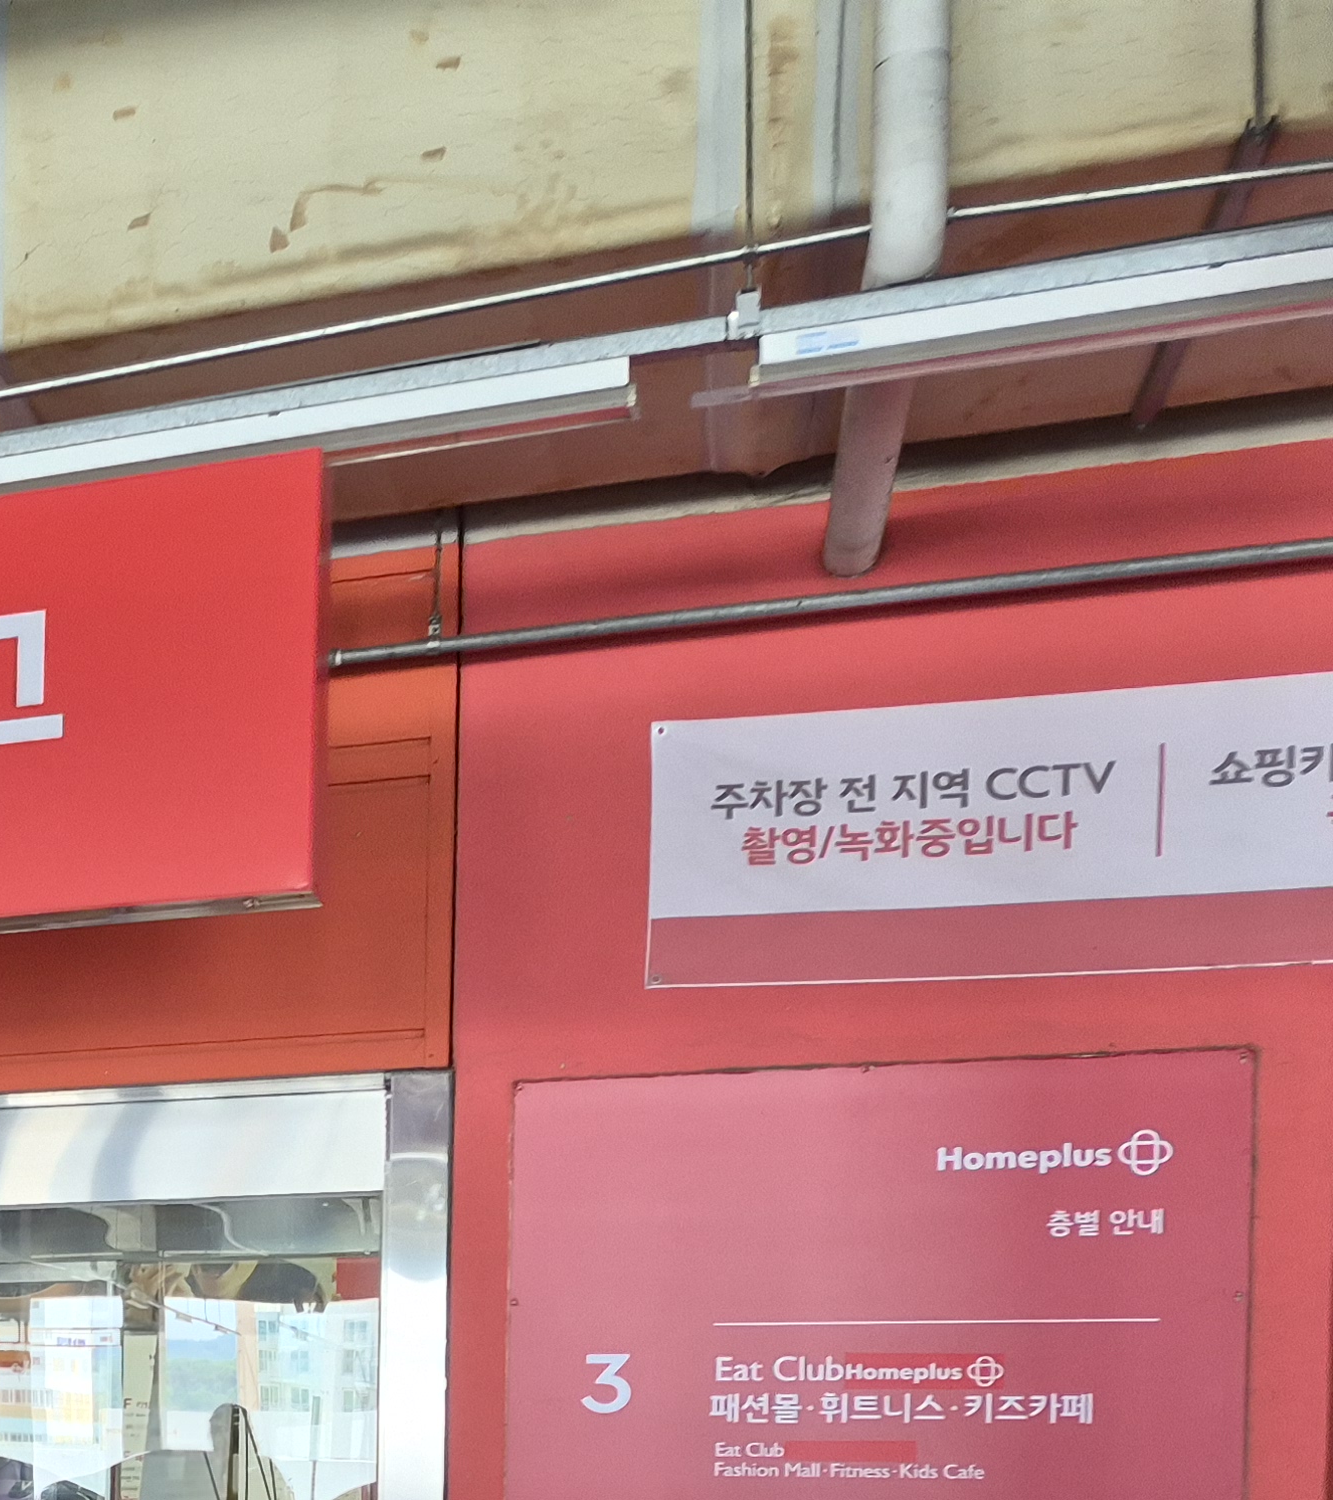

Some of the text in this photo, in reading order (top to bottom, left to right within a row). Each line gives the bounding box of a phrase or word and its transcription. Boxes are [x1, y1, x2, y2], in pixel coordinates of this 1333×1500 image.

[710, 761, 1117, 820] 주차장 전 지역 CCTV
[741, 810, 1079, 866] 촬영/녹화중입니다
[936, 1142, 1113, 1175] Homeplus
[1046, 1207, 1165, 1238] 층별 안내
[580, 1353, 632, 1414] 3
[715, 1354, 963, 1384] Eat Club Homeplus
[714, 1442, 785, 1458] Eat Club
[714, 1462, 780, 1477] Fashion
[943, 1464, 985, 1480] Cafe
